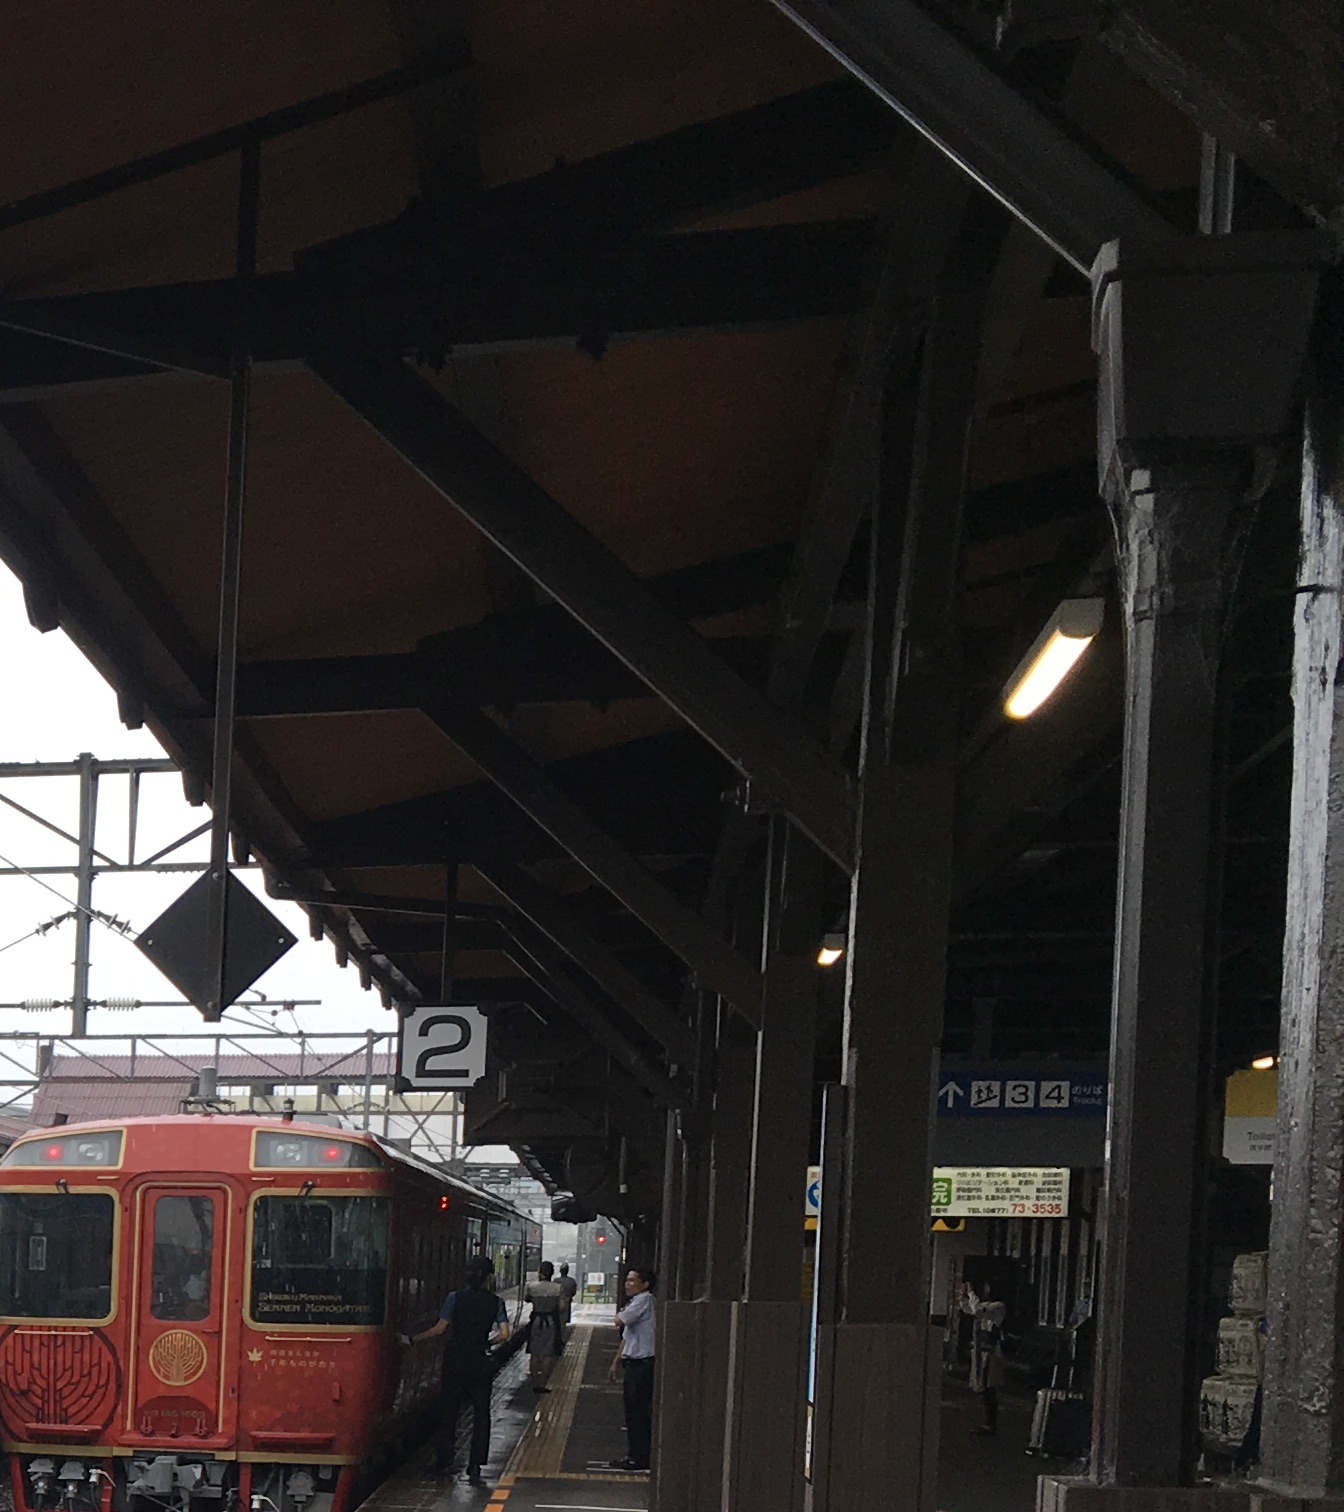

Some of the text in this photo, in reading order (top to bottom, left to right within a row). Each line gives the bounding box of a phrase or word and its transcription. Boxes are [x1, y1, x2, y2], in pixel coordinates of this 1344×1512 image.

[415, 1014, 472, 1078] 2
[1010, 1083, 1104, 1104] 3 4 のりば
